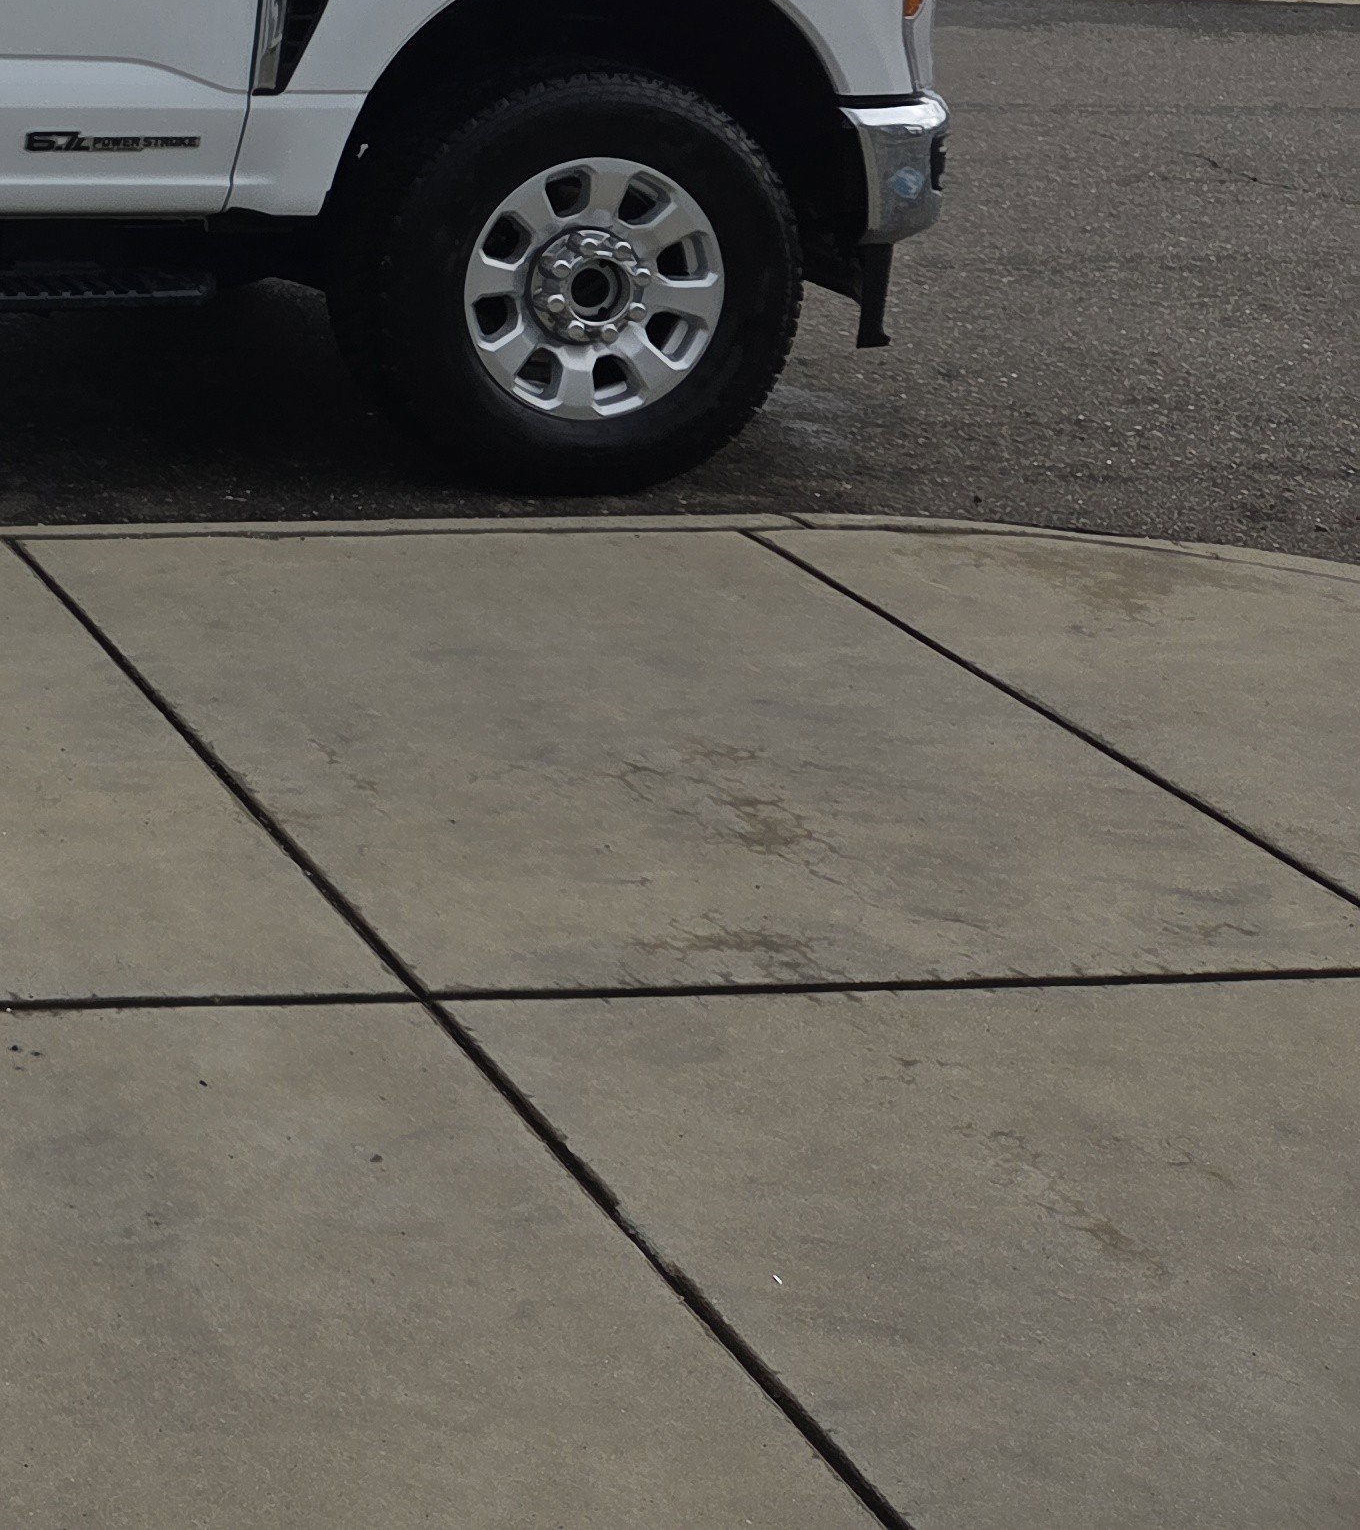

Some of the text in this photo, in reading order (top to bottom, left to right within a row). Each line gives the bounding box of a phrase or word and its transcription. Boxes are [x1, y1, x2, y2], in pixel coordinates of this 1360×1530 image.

[25, 131, 201, 152] 6.7L POWER STROKE
